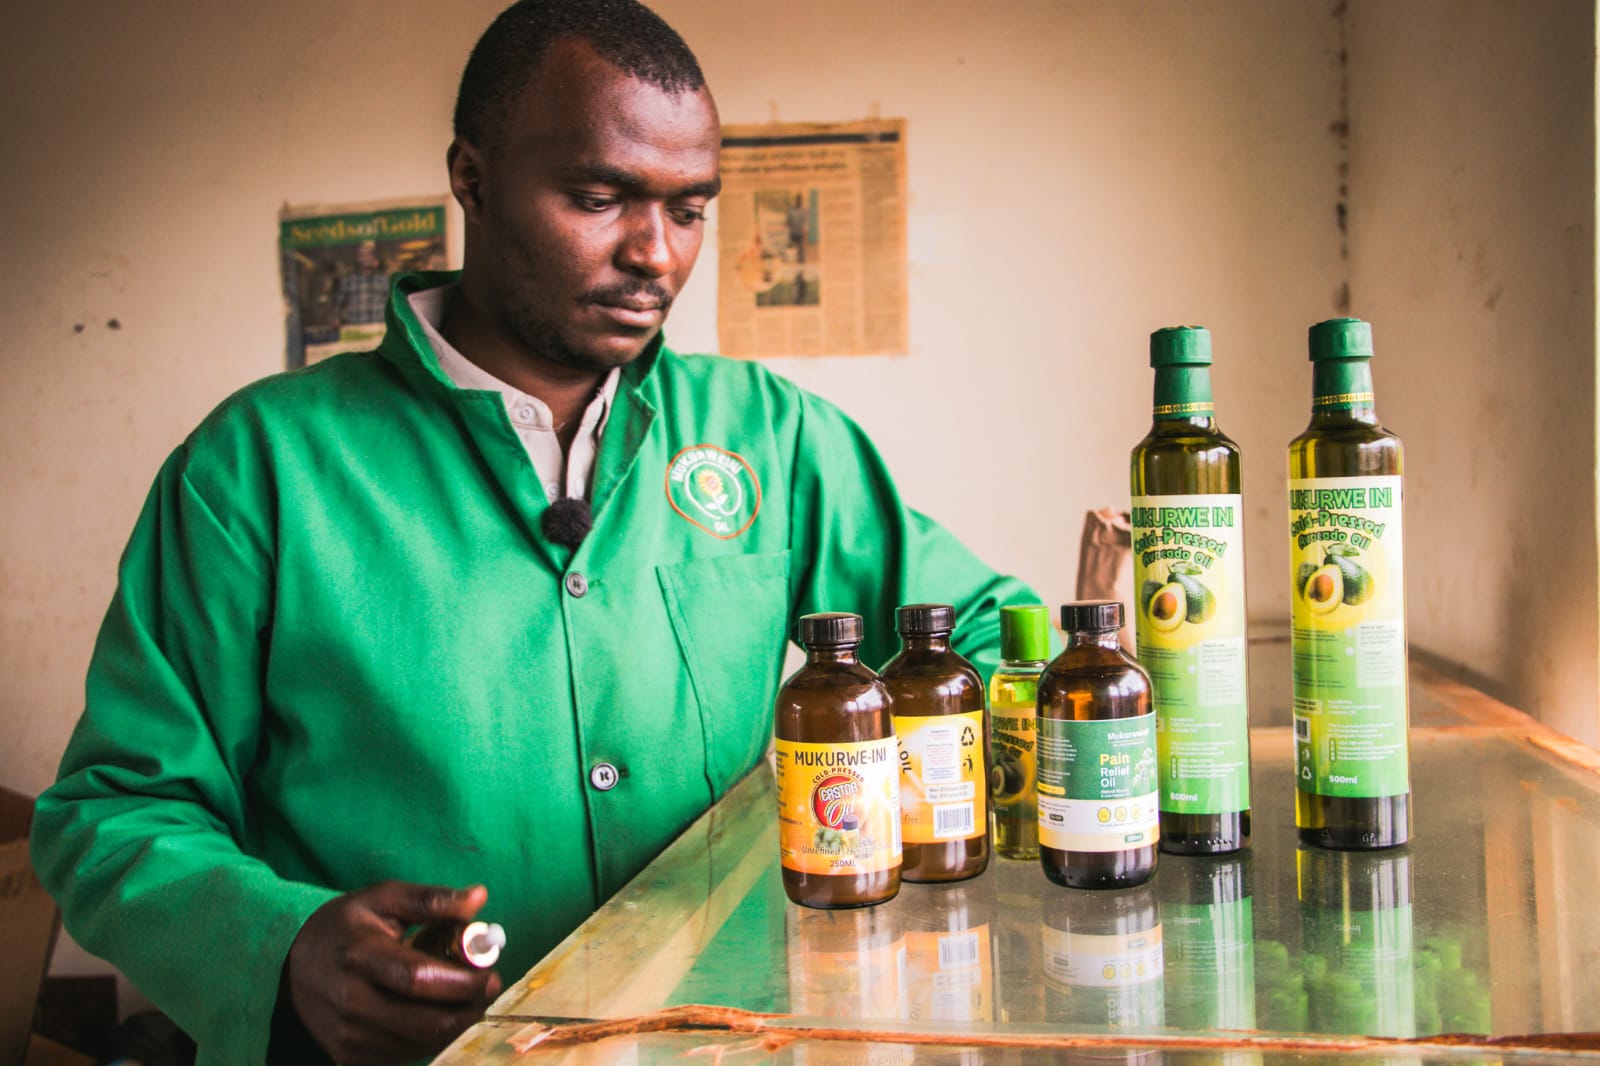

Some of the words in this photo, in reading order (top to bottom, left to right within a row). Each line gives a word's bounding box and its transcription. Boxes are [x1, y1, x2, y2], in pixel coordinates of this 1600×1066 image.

[1298, 529, 1347, 550] Avocado
[1350, 533, 1371, 550] Oil
[1142, 547, 1191, 568] Avocado
[1194, 551, 1214, 569] Oil
[795, 747, 887, 767] MUKURWE-INI
[900, 751, 912, 774] OIL
[1099, 752, 1130, 766] Pain
[1100, 766, 1130, 777] Relief
[1100, 778, 1116, 788] Oil
[1329, 775, 1358, 784] 500ml
[1170, 792, 1198, 801] 500ml
[801, 845, 840, 855] Unrefined
